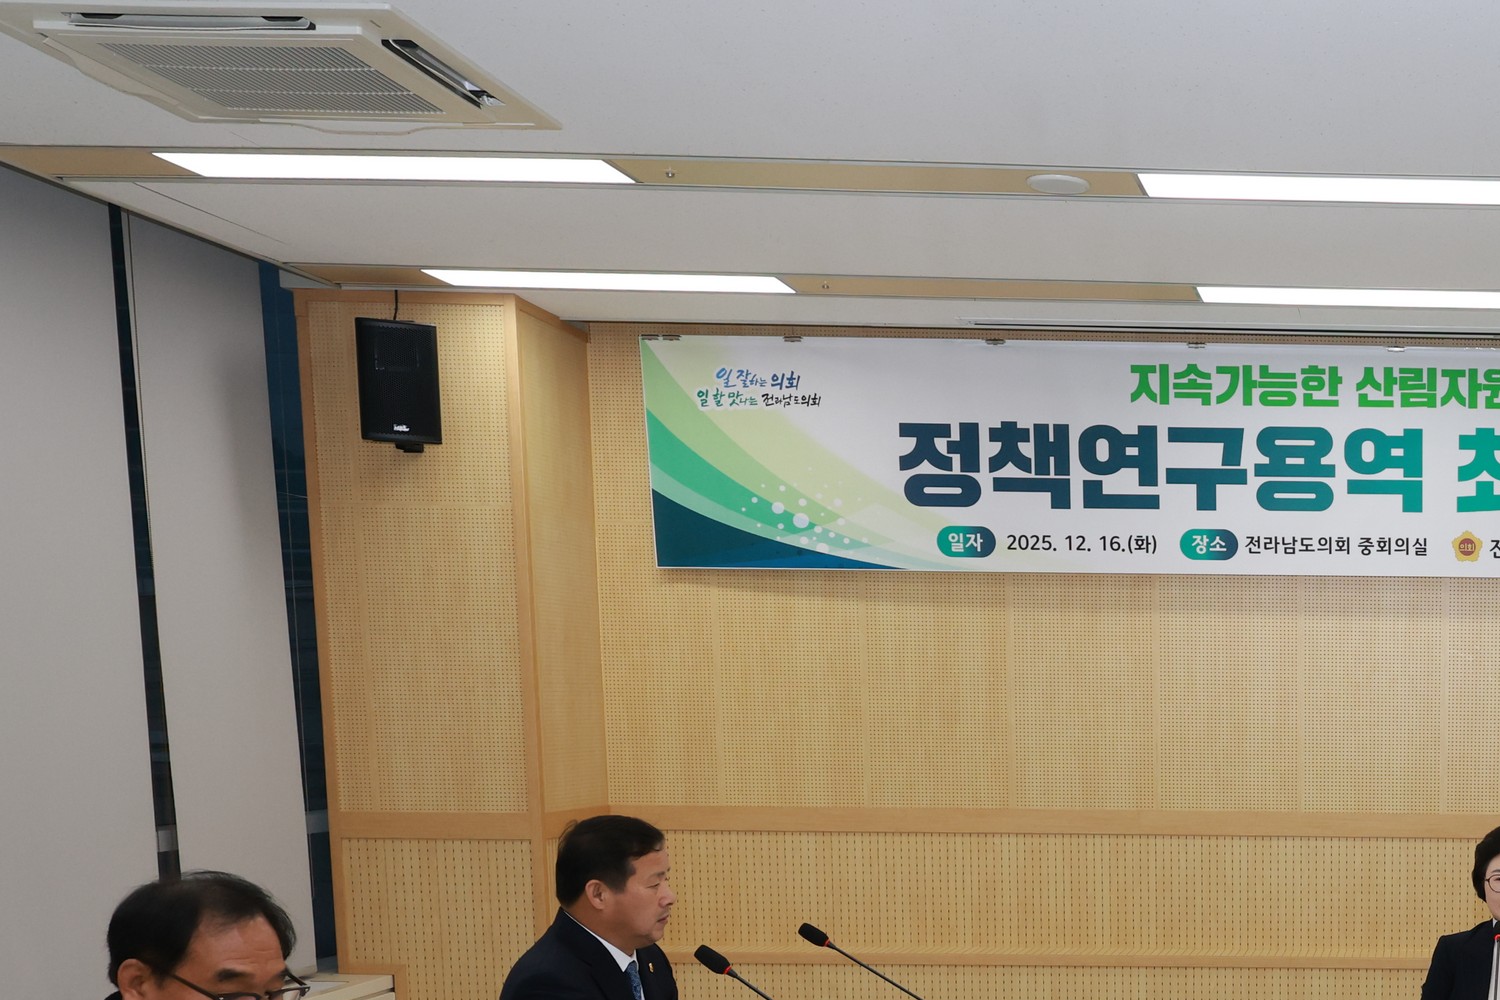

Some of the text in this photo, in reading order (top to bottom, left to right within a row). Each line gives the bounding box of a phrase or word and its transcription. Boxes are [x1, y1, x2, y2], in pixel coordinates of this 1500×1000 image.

[715, 367, 801, 391] 일 잘하는 의회
[1130, 362, 1343, 409] 지속가능한
[761, 392, 822, 408] 전라남도의회
[898, 421, 1423, 512] 정책연구용역
[947, 533, 1429, 557] 일자 2025. 12. 16.(화) 장소 전라남도의회 중회의실
